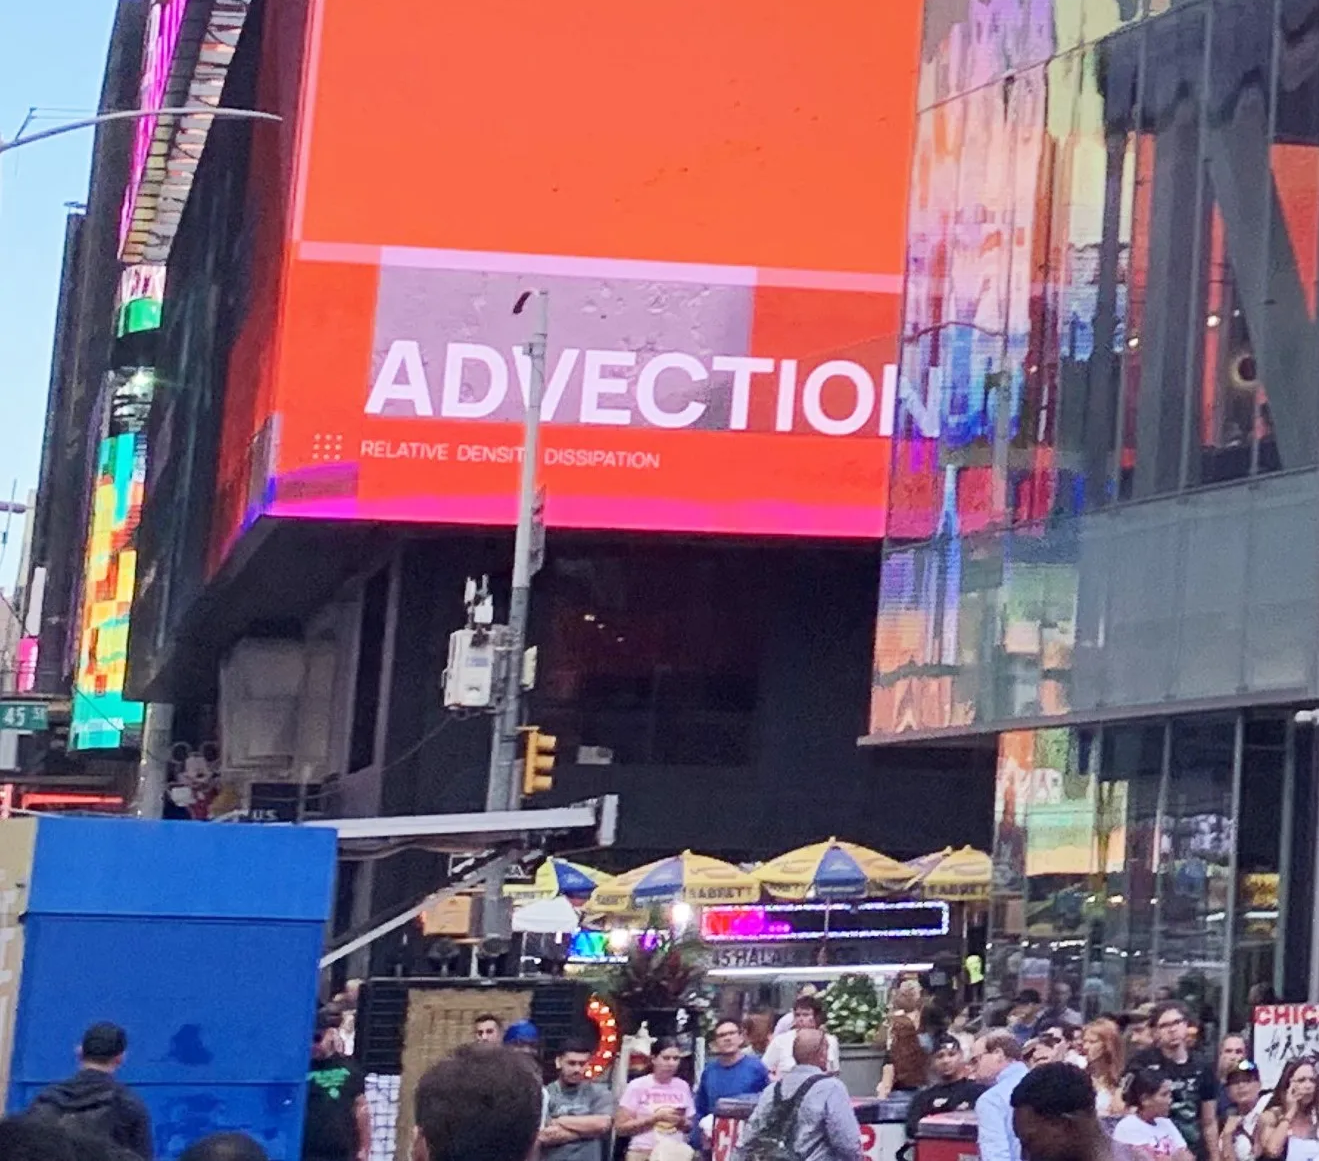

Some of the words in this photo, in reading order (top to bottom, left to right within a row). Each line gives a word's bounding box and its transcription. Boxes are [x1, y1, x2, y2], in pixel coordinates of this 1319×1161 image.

[364, 339, 939, 439] ADVECTION
[361, 441, 448, 461] RELATIVE
[457, 446, 527, 464] DENSIT
[544, 449, 661, 470] DISSIPATION
[3, 707, 25, 727] 45
